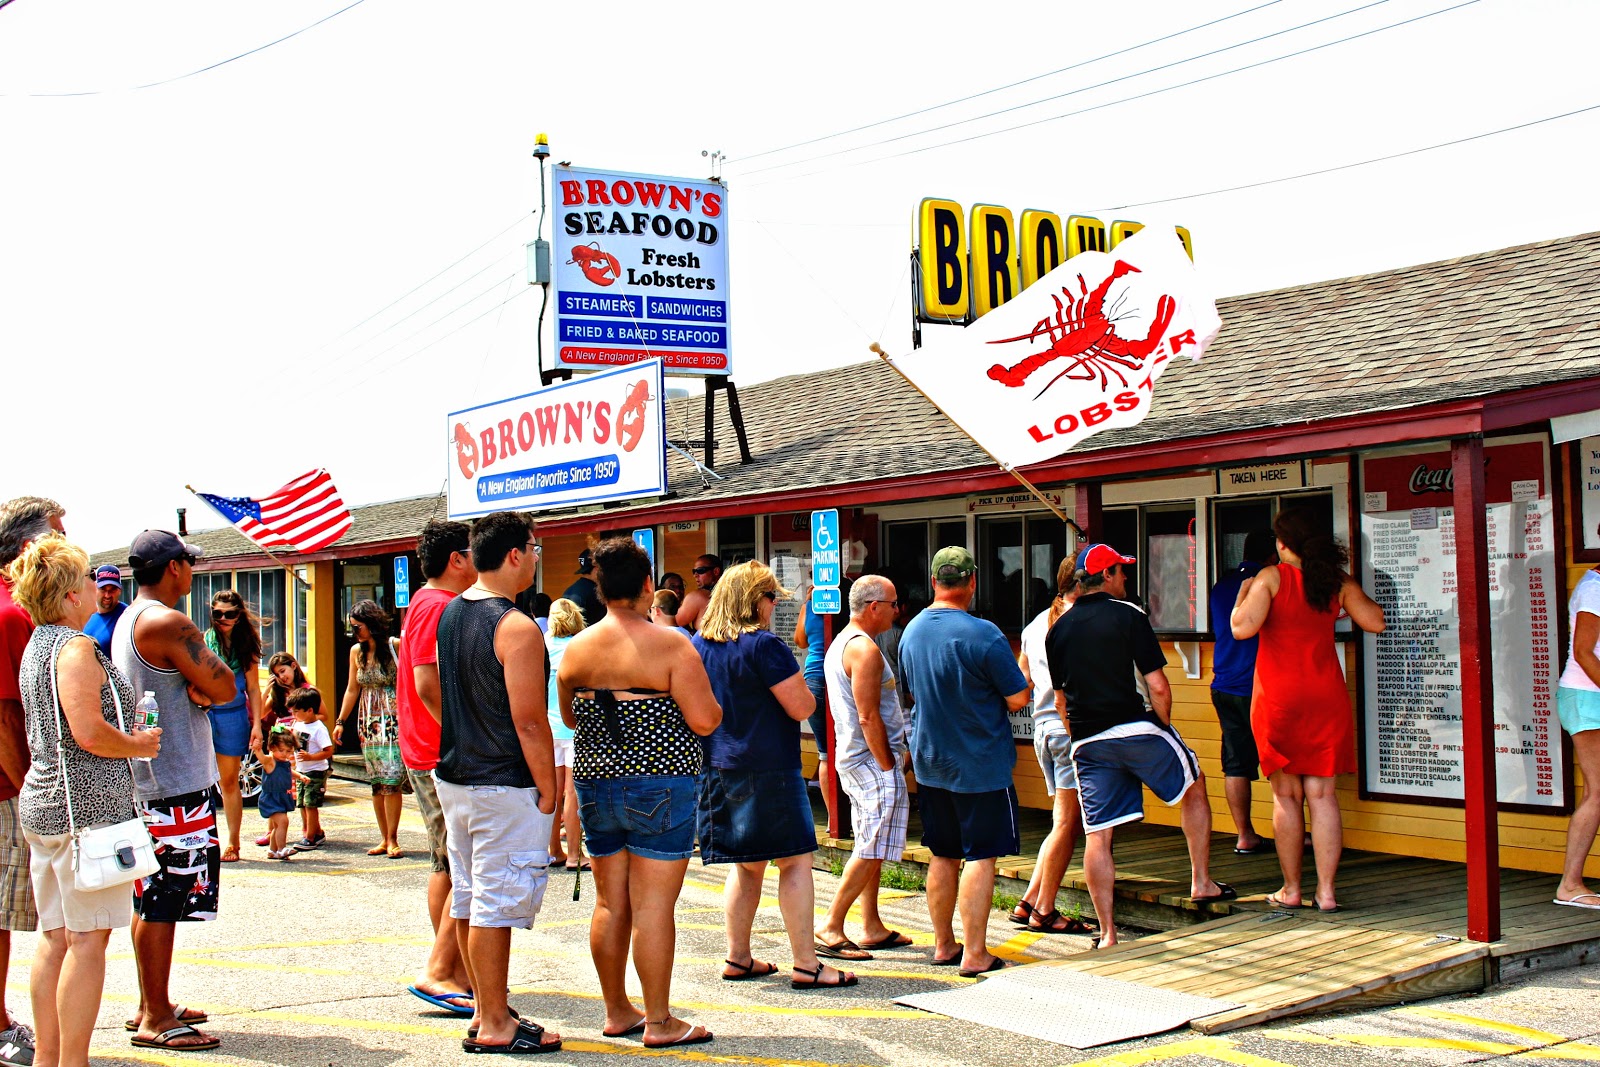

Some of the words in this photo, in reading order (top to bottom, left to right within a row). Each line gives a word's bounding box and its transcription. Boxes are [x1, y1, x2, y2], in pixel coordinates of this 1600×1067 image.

[559, 179, 721, 217] BROWN'S
[564, 211, 719, 245] SEAFOOD
[642, 248, 701, 269] Fresh
[627, 269, 716, 291] Lobsters
[566, 297, 636, 313] STEAMERS
[651, 302, 722, 318] SANDWICHES
[566, 326, 602, 338] FRIED
[607, 327, 614, 338] &
[618, 329, 658, 340] BAKED
[662, 330, 719, 343] SEAFOOD
[576, 351, 596, 361] New
[599, 352, 634, 363] England
[676, 355, 699, 363] Since
[702, 356, 723, 365] 1950"
[480, 400, 611, 468] BROWN'S
[488, 481, 504, 494] New
[506, 476, 534, 494] England
[536, 469, 568, 488] Favorite
[570, 467, 591, 483] Since
[594, 461, 617, 478] 1950"
[1230, 472, 1255, 484] TAKEN
[1261, 469, 1287, 481] HERE
[1032, 493, 1050, 501] HE
[814, 550, 838, 564] PARKING
[819, 568, 833, 582] ONLY
[1010, 723, 1021, 734] ov.
[1024, 723, 1031, 734] 15
